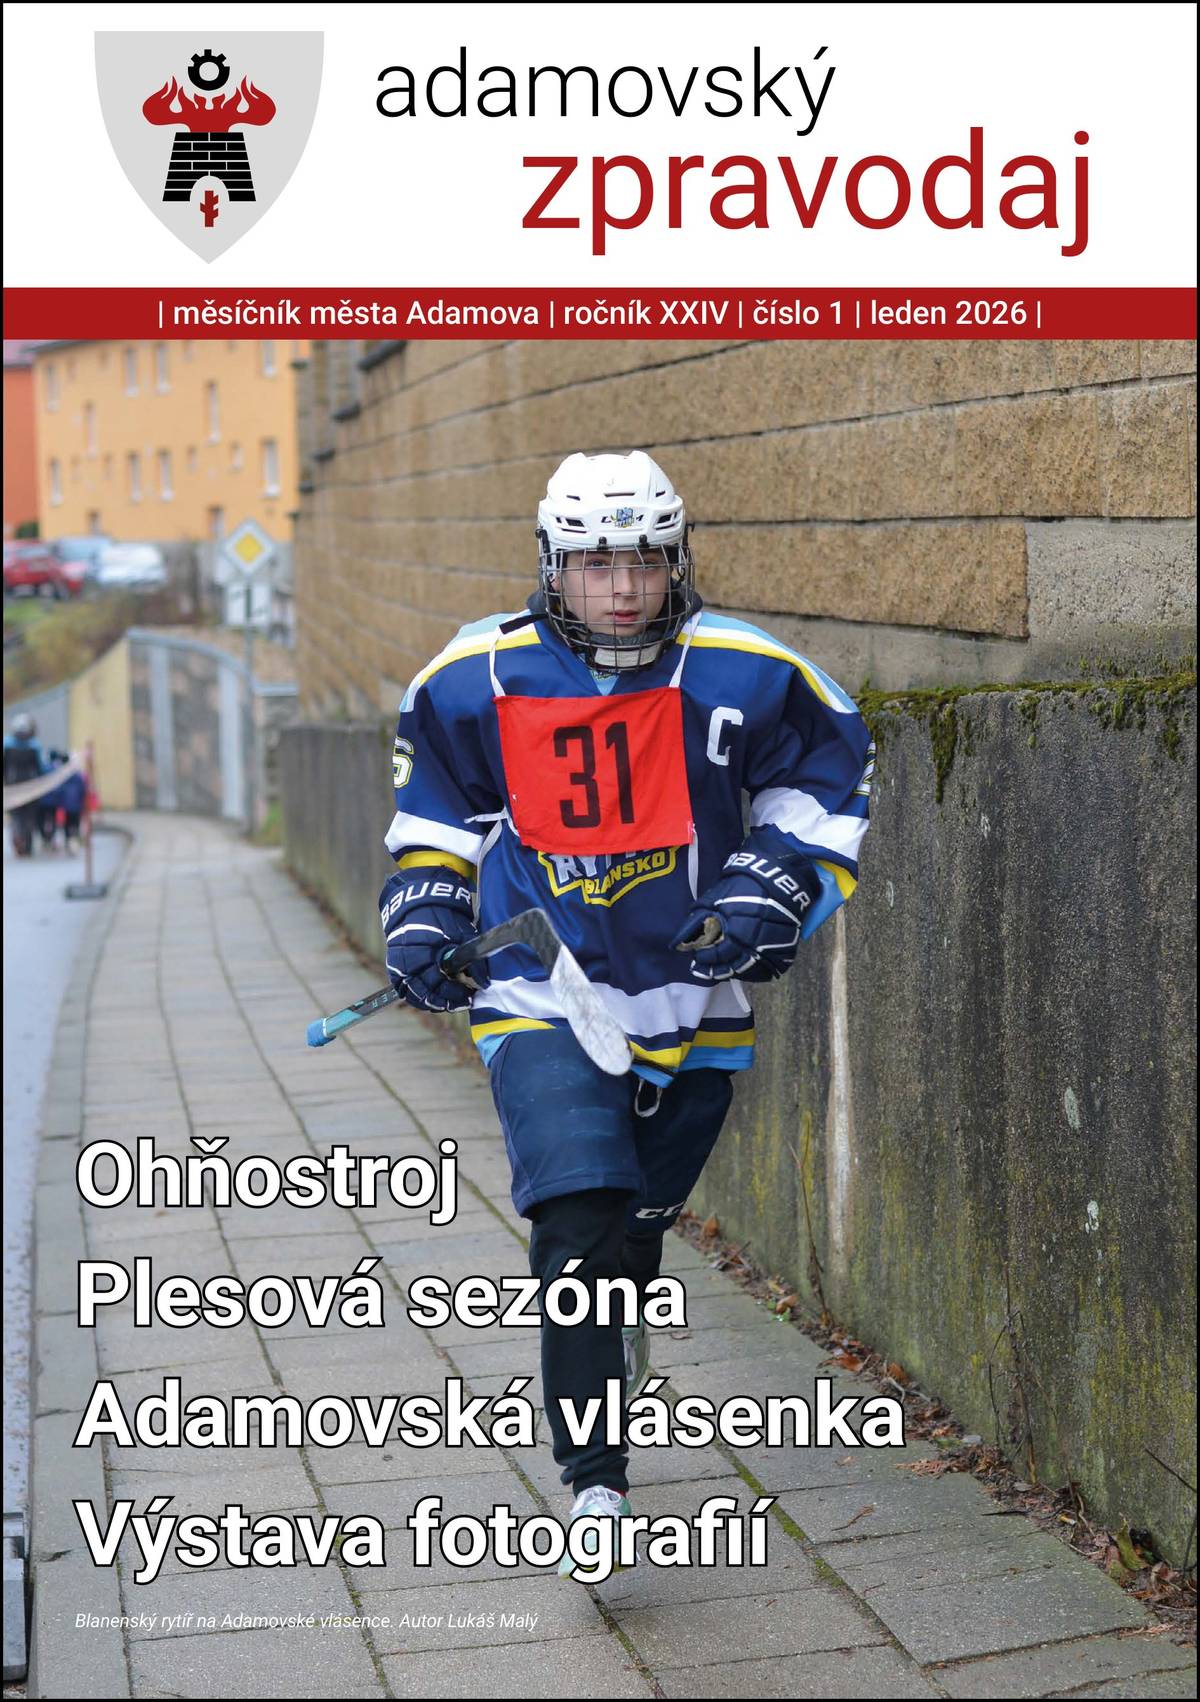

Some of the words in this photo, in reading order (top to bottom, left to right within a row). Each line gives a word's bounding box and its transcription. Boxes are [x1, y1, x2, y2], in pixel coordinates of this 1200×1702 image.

[706, 705, 744, 767] C
[553, 721, 635, 829] 31
[583, 851, 667, 895] BLANSKO
